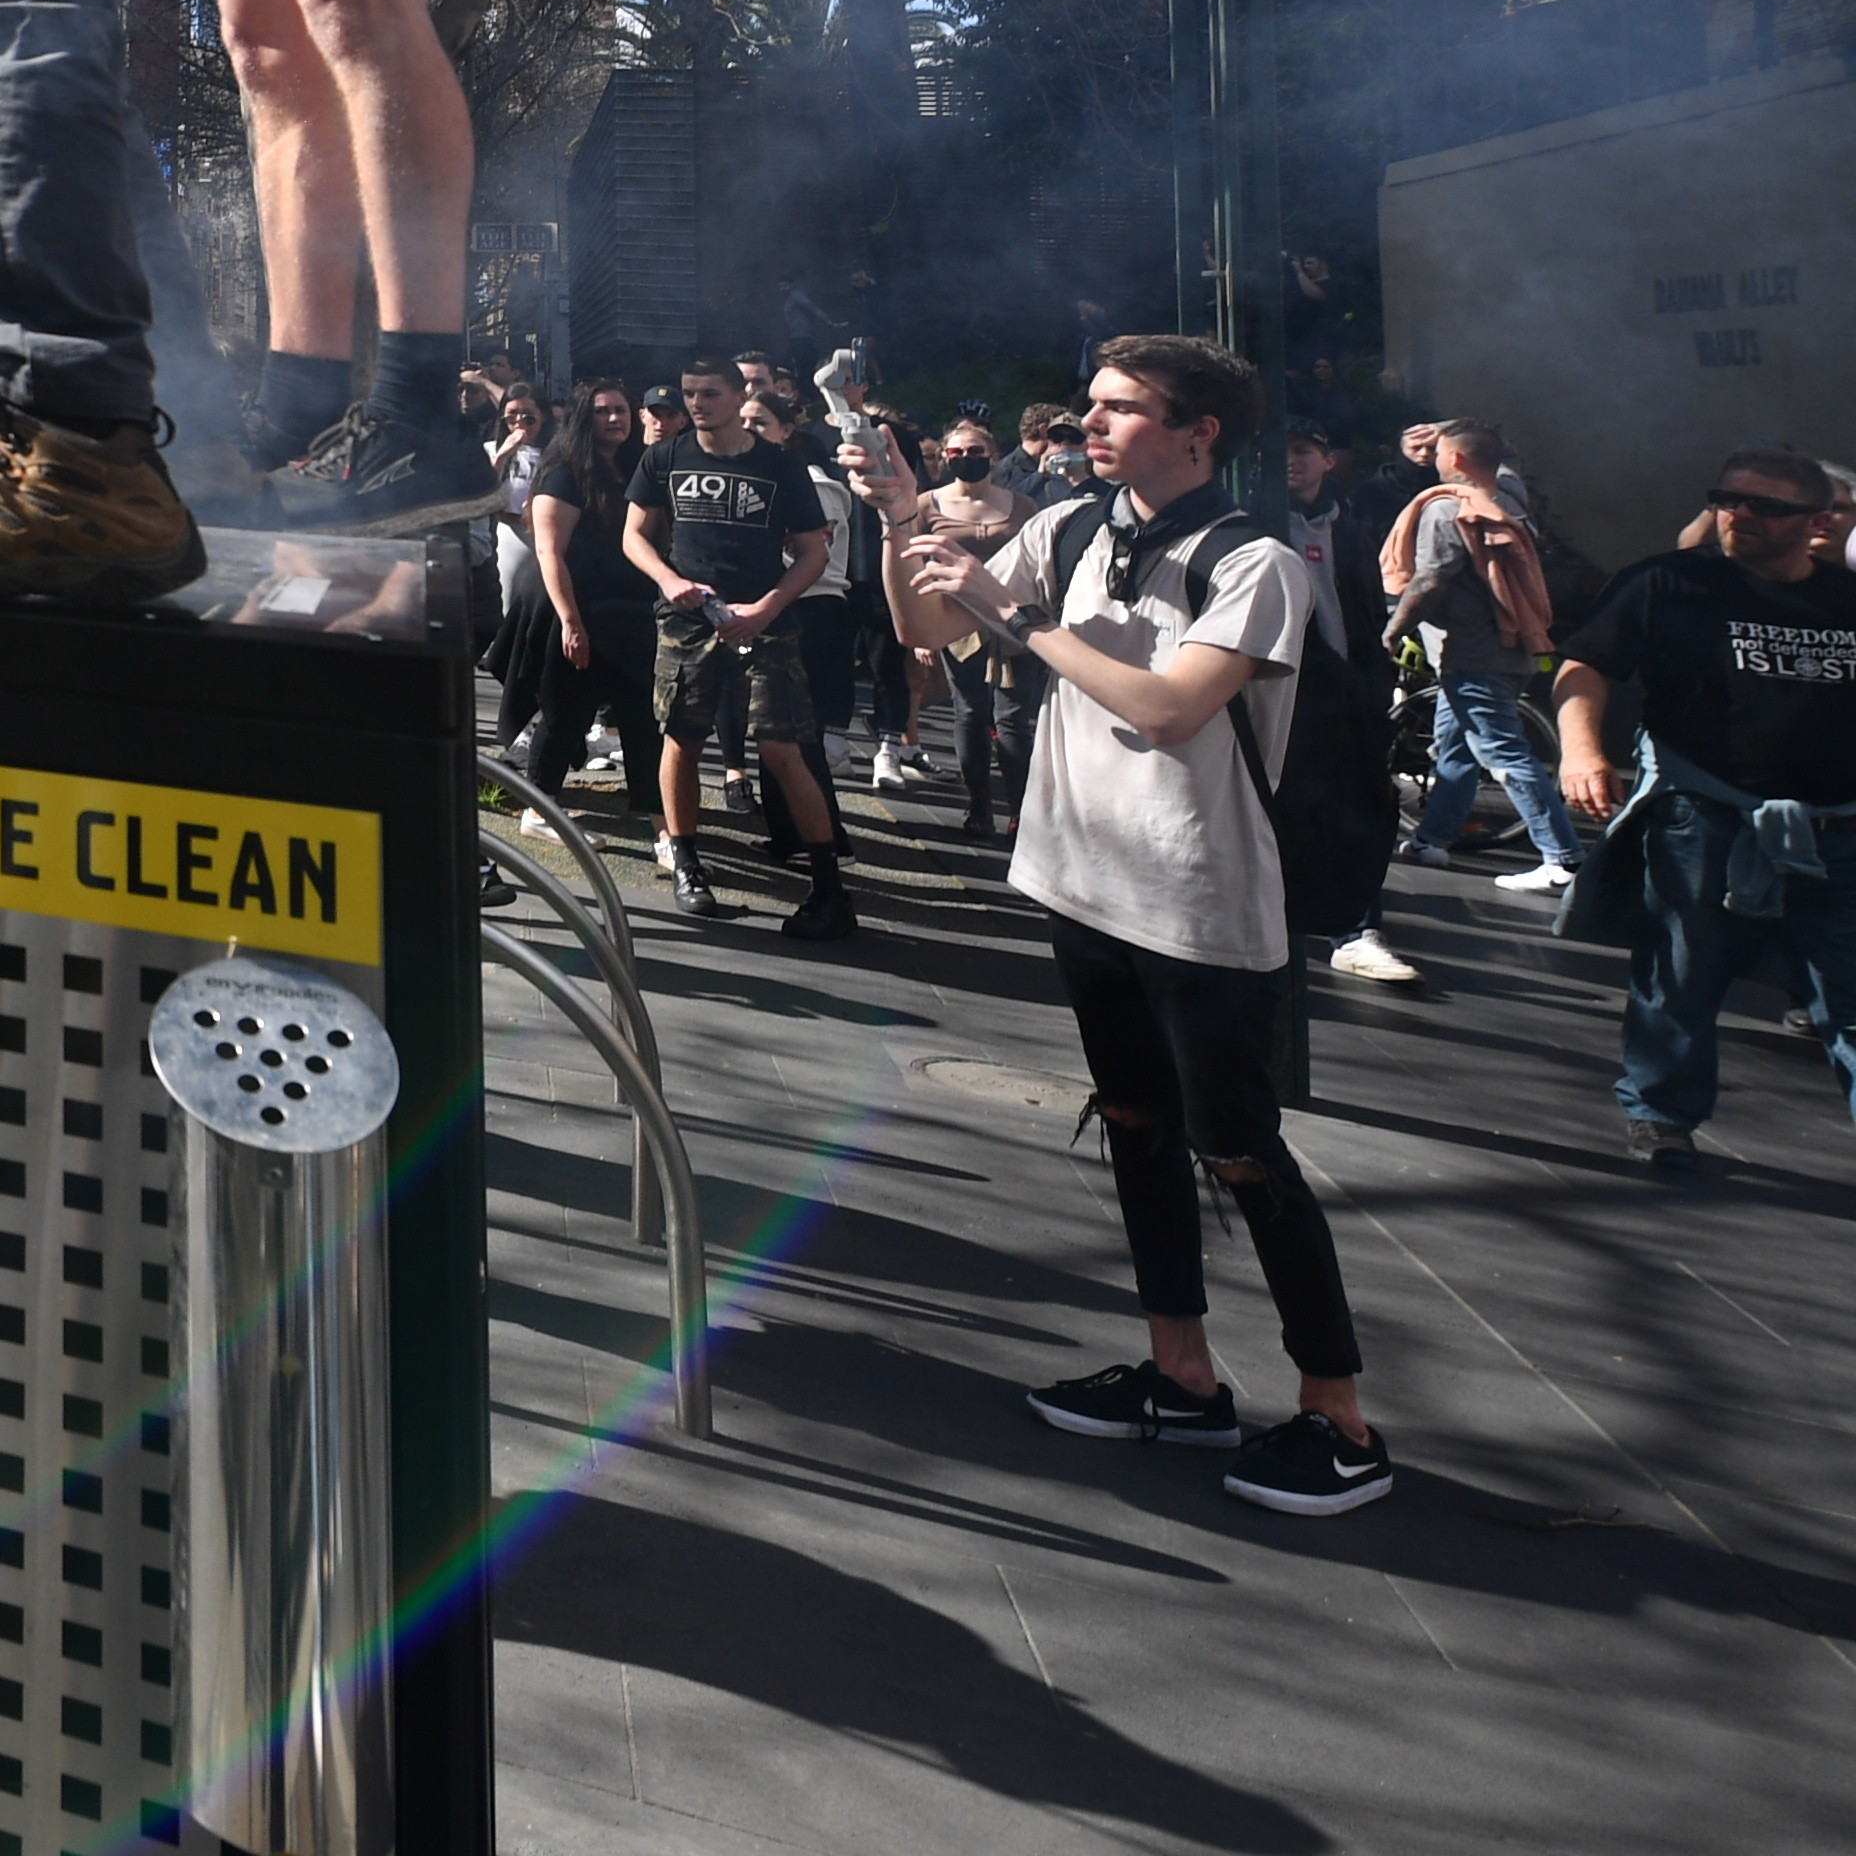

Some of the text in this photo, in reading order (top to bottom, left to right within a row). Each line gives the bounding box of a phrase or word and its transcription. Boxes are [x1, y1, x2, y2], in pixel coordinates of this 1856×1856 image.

[676, 474, 726, 500] 49
[1727, 620, 1856, 646] FREEDOM
[1732, 638, 1764, 651] not
[1735, 649, 1771, 673] IS
[75, 808, 339, 925] CLEAN
